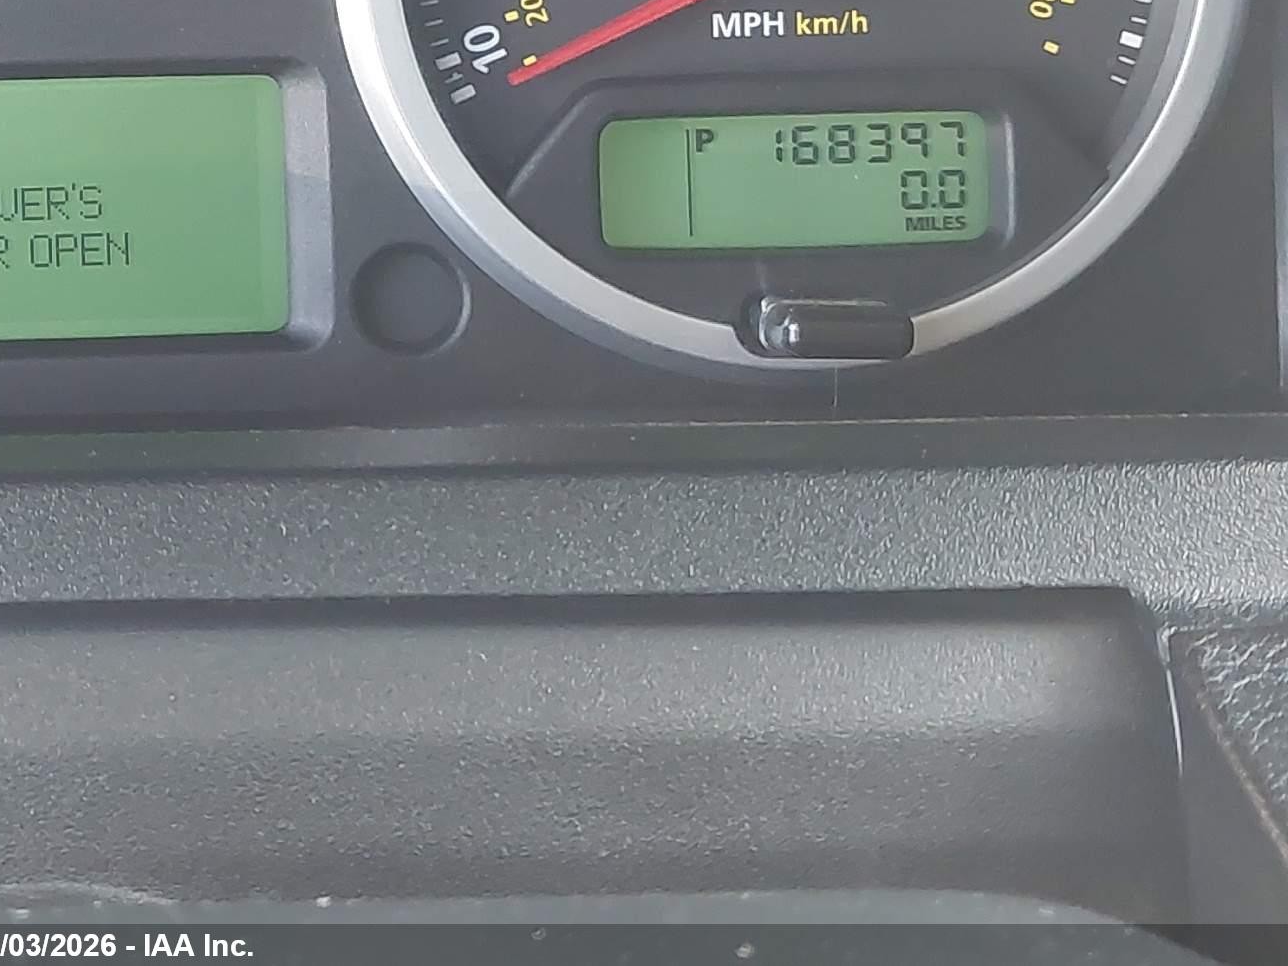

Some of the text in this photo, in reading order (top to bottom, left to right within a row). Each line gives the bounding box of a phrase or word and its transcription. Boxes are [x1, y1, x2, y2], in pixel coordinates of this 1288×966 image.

[712, 9, 868, 38] MPH km/h
[463, 25, 508, 74] 10
[695, 121, 967, 166] P 168397
[900, 169, 967, 211] 0.0
[905, 215, 969, 232] MILES
[29, 232, 130, 268] OPEN
